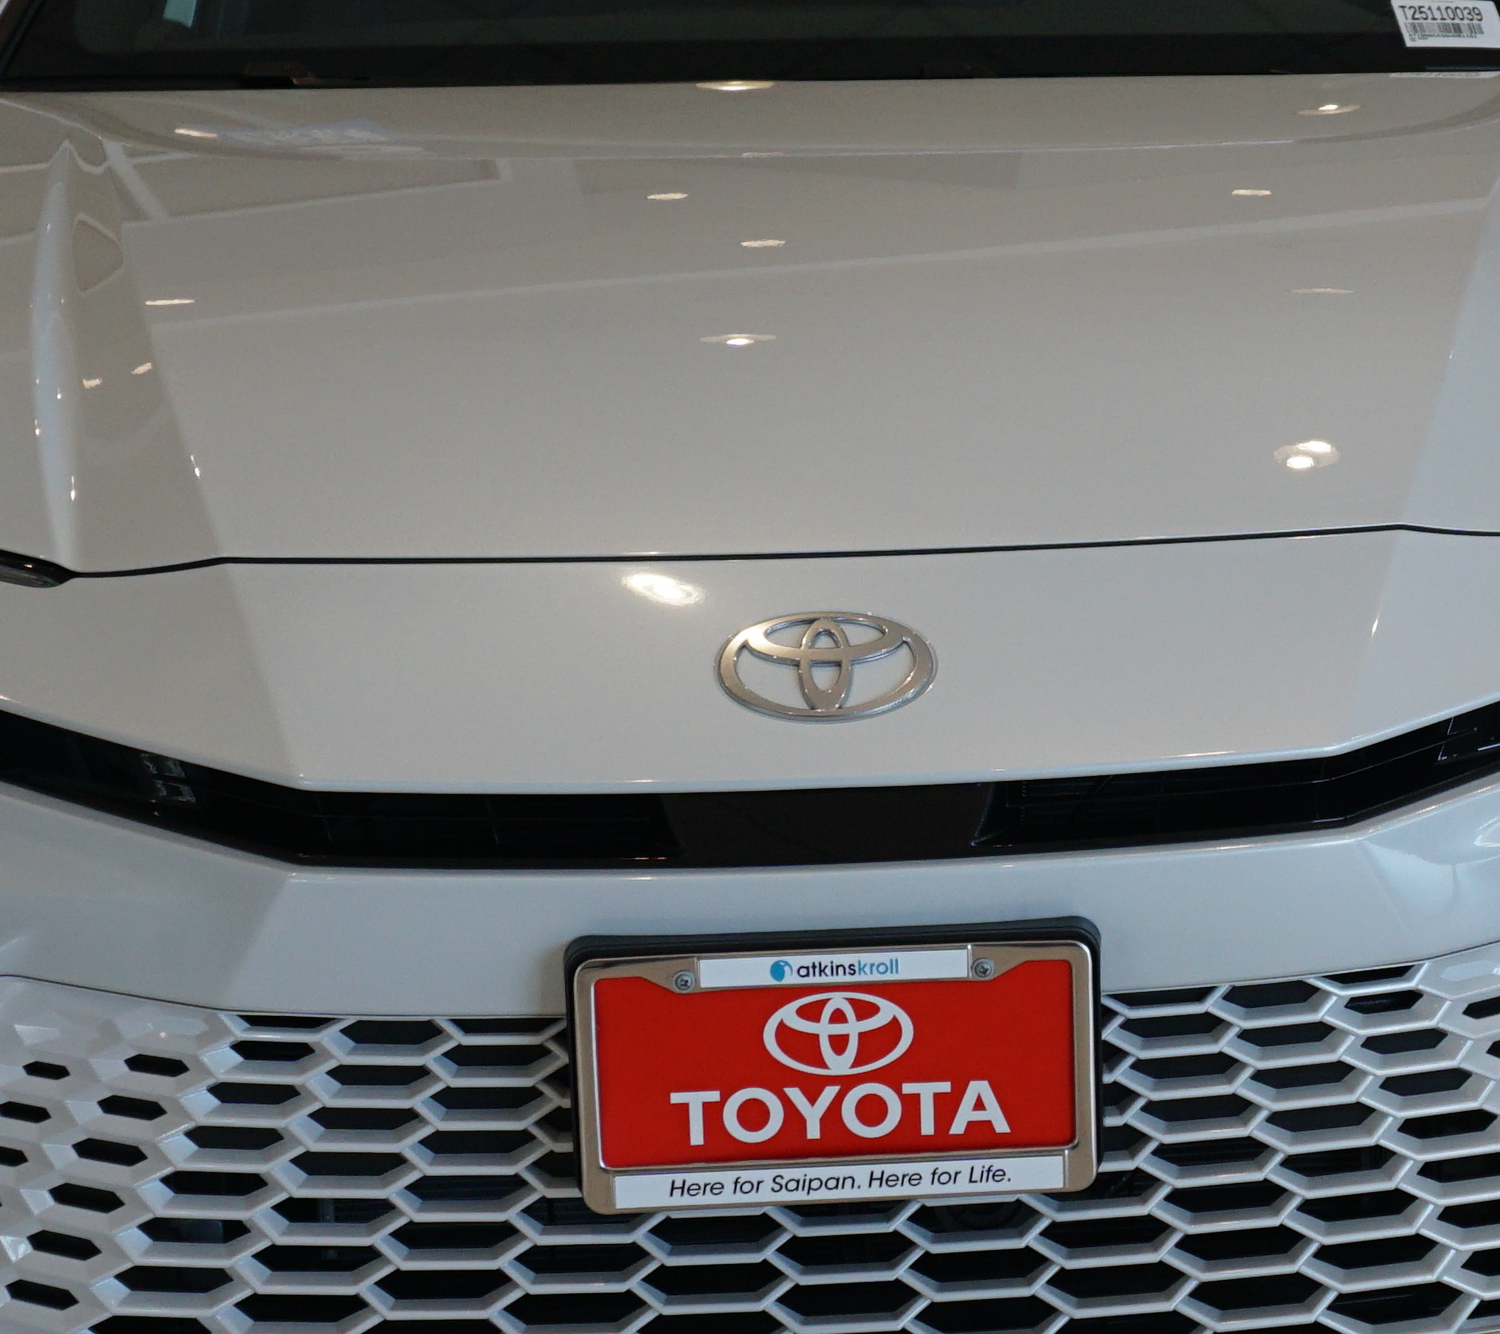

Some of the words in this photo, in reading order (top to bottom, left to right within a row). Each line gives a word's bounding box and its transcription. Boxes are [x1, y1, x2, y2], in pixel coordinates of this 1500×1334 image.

[1398, 5, 1483, 22] T25110039
[795, 958, 900, 980] atkinskroll
[670, 1080, 1011, 1146] TOYOTA
[670, 1179, 724, 1198] Here
[732, 1176, 764, 1195] for
[771, 1172, 861, 1197] Saipan.
[868, 1170, 922, 1189] Here
[930, 1167, 962, 1186] for
[968, 1164, 1012, 1184] Life.
